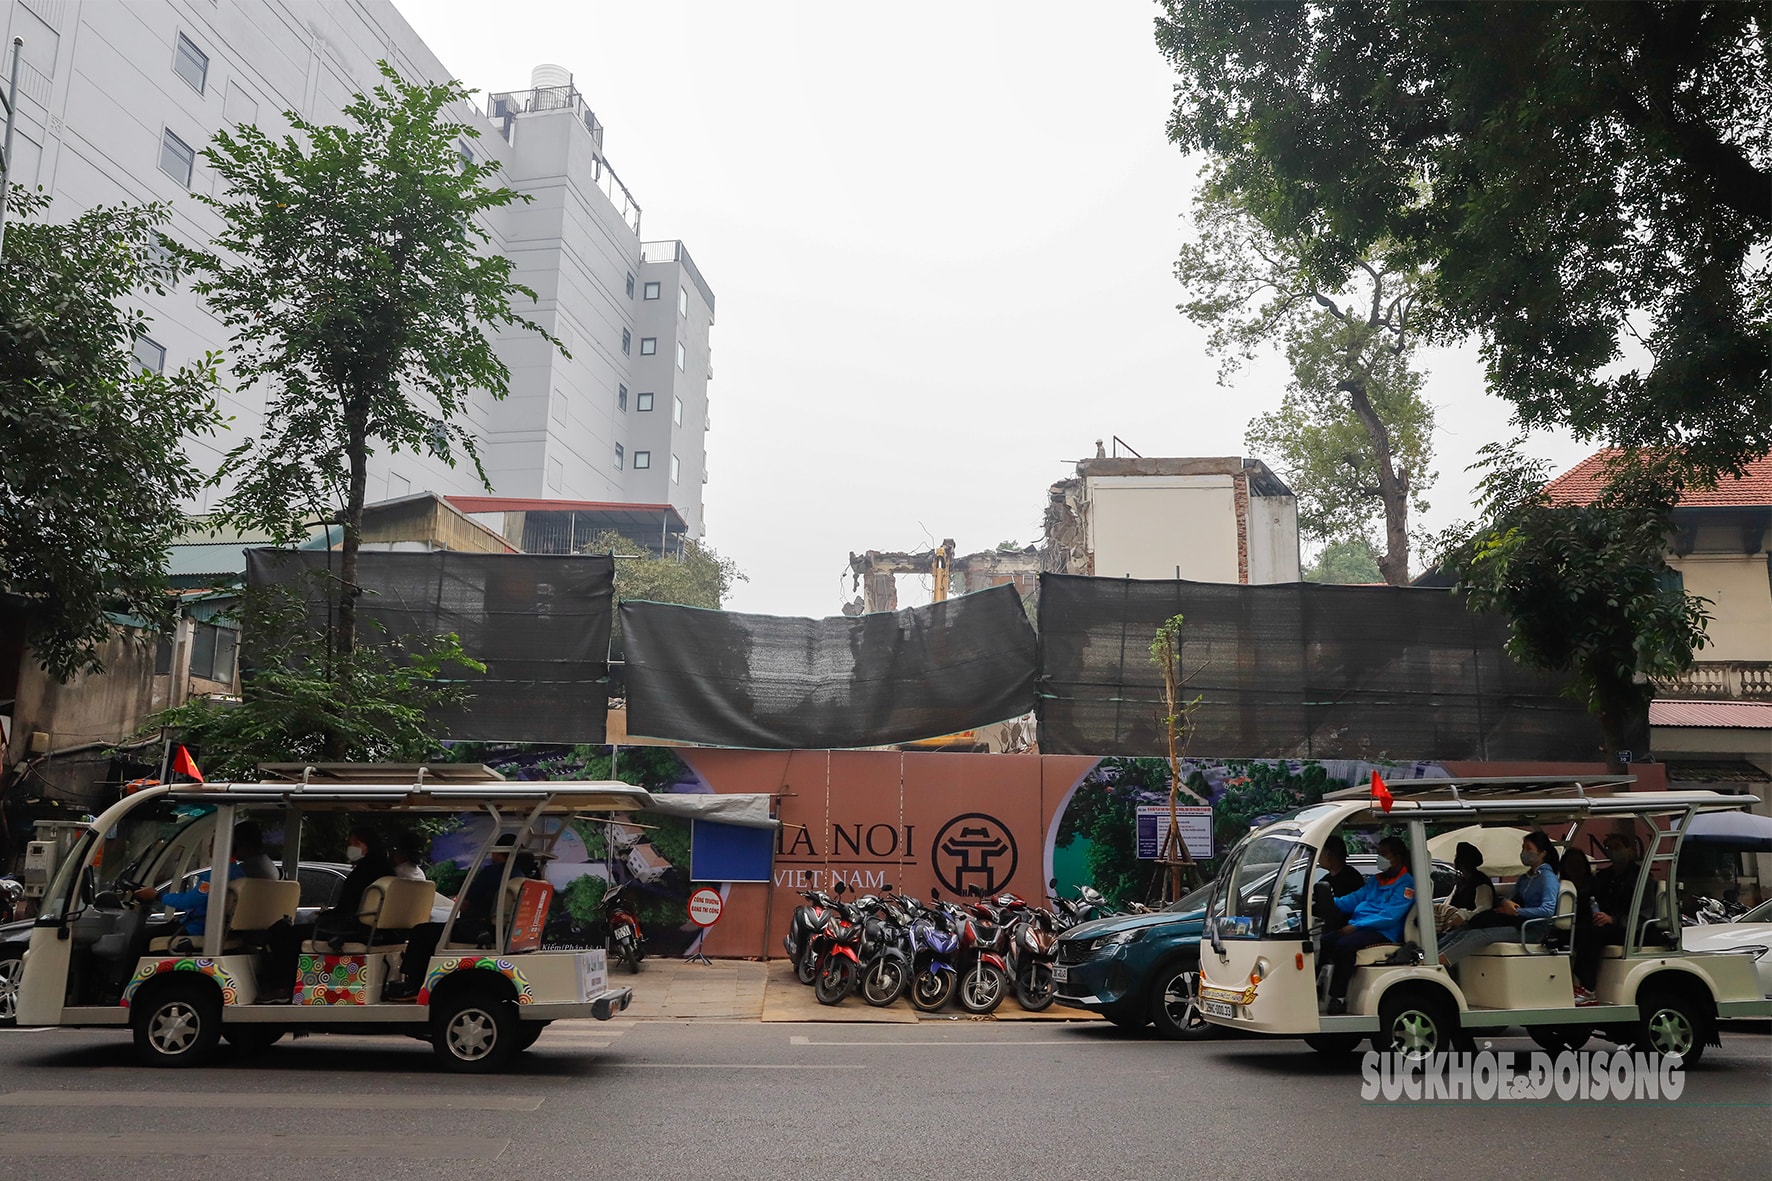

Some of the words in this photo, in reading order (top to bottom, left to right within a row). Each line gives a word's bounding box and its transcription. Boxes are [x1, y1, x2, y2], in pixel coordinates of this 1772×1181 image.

[831, 823, 916, 857] NOI
[774, 869, 823, 889] VIET
[831, 869, 885, 889] NAM
